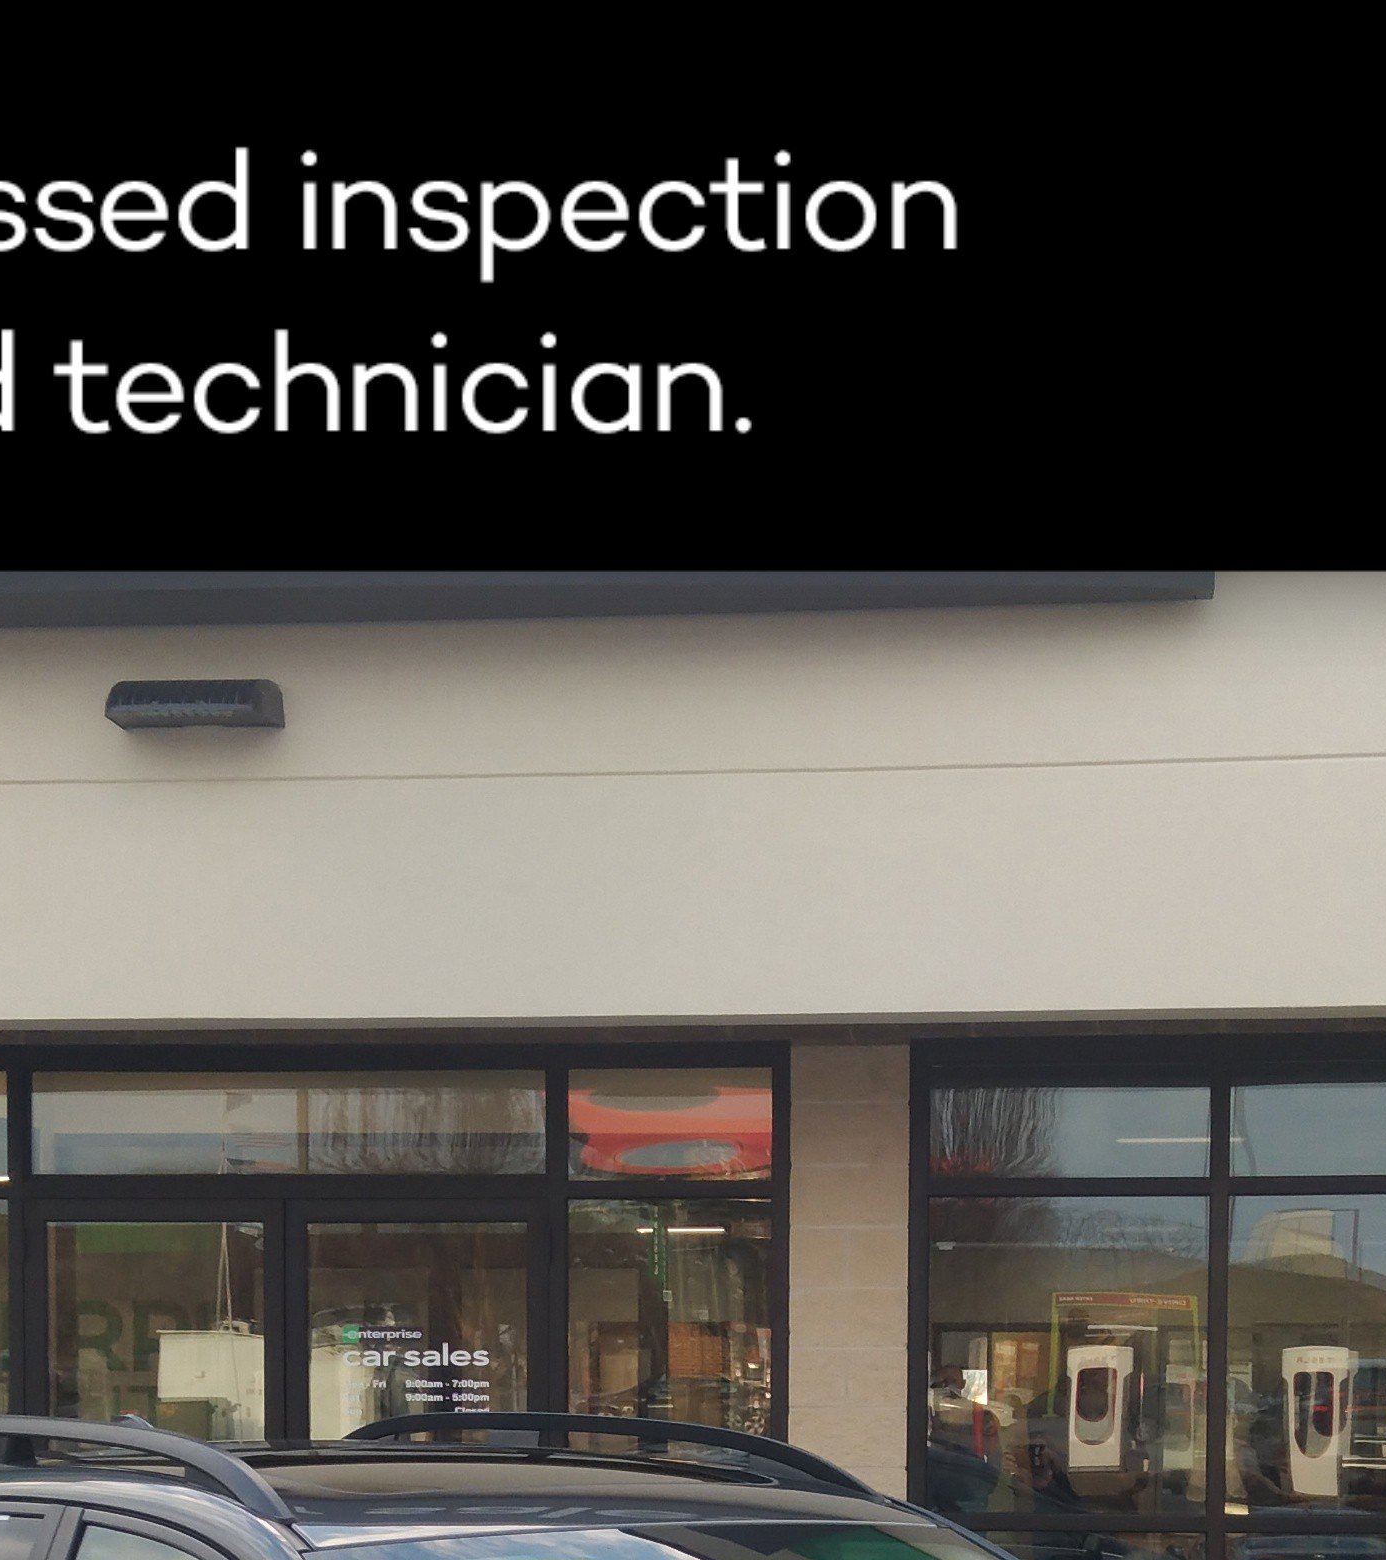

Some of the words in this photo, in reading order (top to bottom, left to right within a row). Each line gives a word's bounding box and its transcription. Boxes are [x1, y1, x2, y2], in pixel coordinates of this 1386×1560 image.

[343, 1328, 423, 1342] enterprise
[343, 1349, 396, 1367] car
[403, 1342, 490, 1367] sales
[373, 1379, 386, 1388] Fri
[405, 1379, 443, 1389] 9:00am
[452, 1379, 490, 1391] 7:00pm
[405, 1392, 443, 1402] 9:00am
